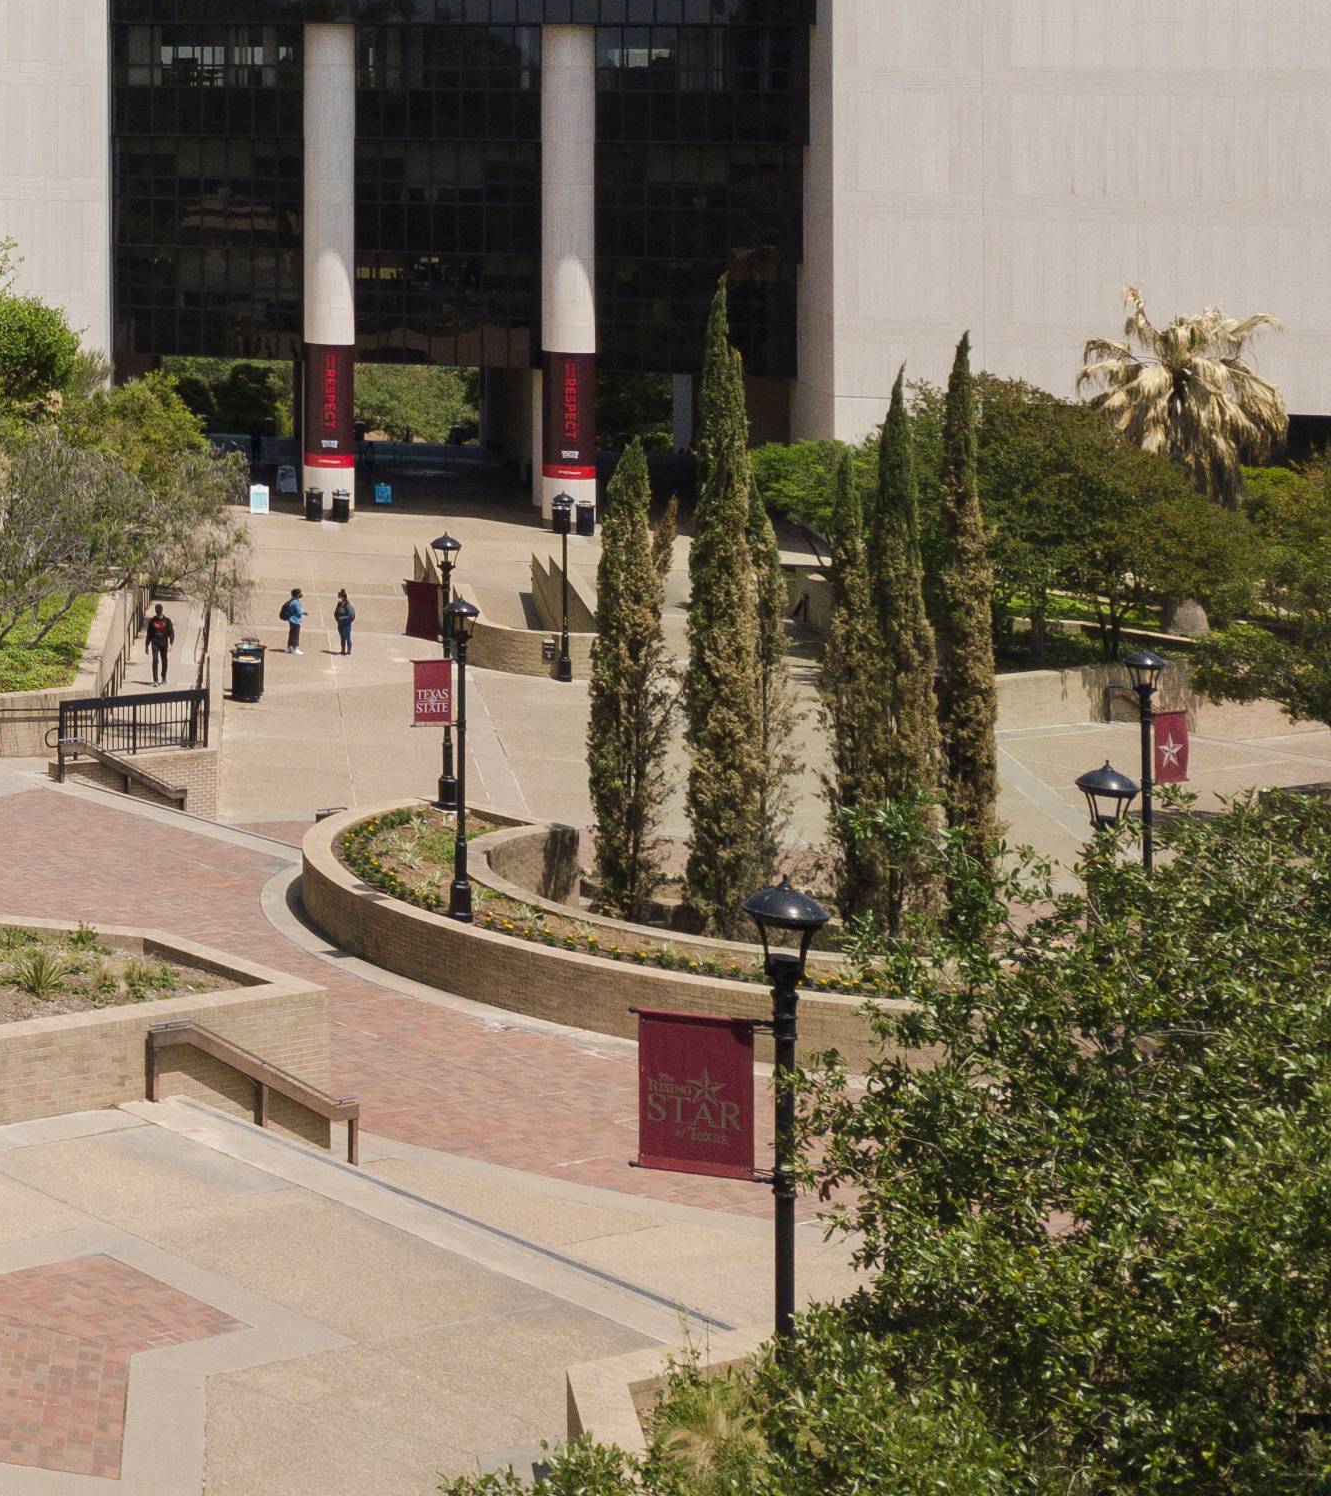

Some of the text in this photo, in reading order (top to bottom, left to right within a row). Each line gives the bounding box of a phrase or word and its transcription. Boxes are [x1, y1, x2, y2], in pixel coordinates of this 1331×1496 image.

[323, 368, 338, 429] RESPECT
[564, 378, 578, 439] RESPECT
[416, 689, 449, 700] TEXAS
[416, 702, 449, 713] STATE
[659, 1072, 676, 1083] The
[649, 1079, 692, 1096] RISING
[648, 1094, 745, 1133] STAR
[689, 1126, 729, 1145] Texas
